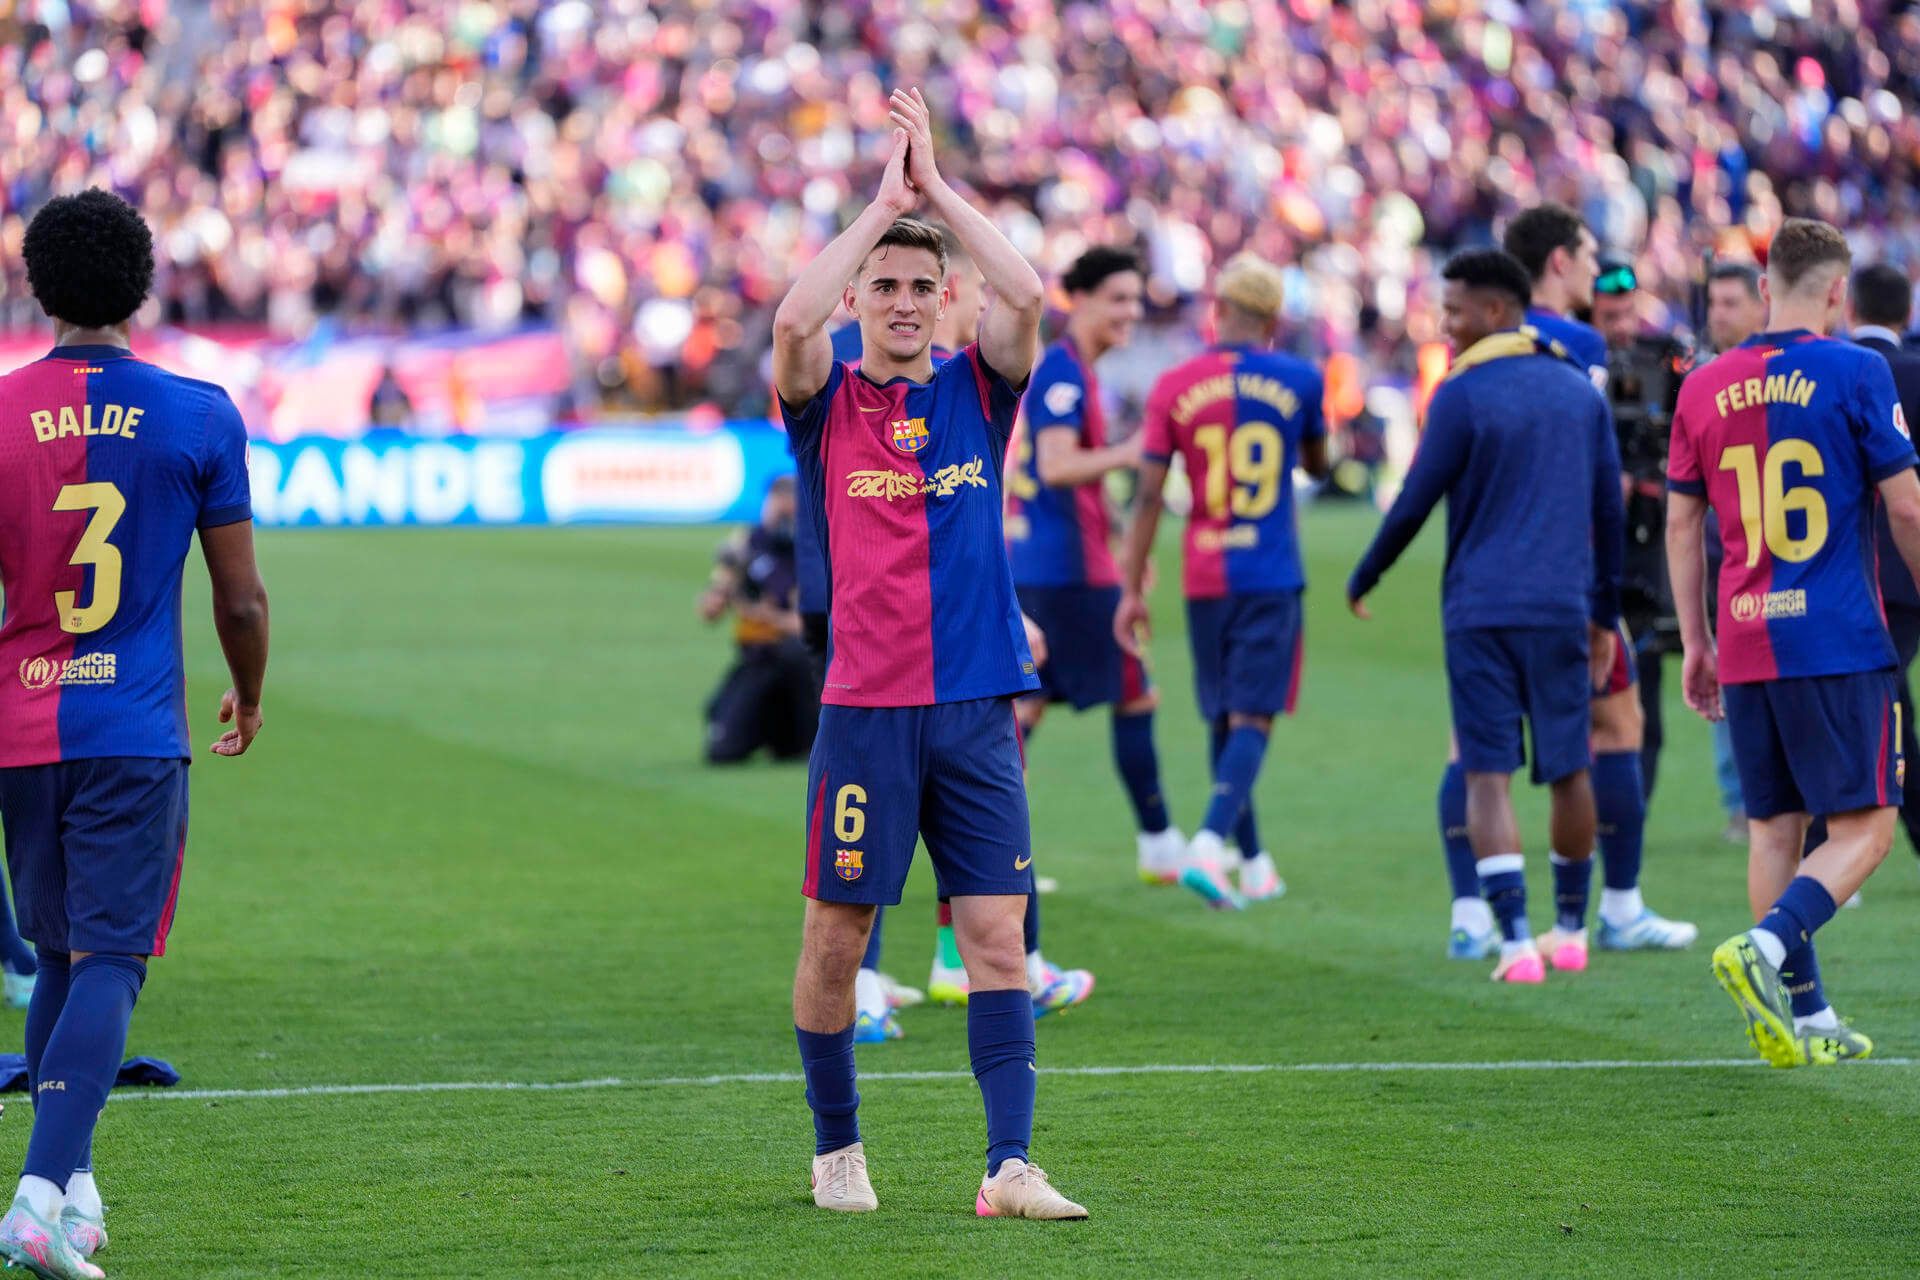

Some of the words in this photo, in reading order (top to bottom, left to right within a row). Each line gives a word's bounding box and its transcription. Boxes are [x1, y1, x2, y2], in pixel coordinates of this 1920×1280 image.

[30, 404, 145, 443] BALDE
[1715, 369, 1817, 418] FERMÍN
[1194, 421, 1283, 520] 19
[1718, 438, 1829, 568] 16
[52, 482, 127, 634] 3
[834, 784, 867, 843] 6
